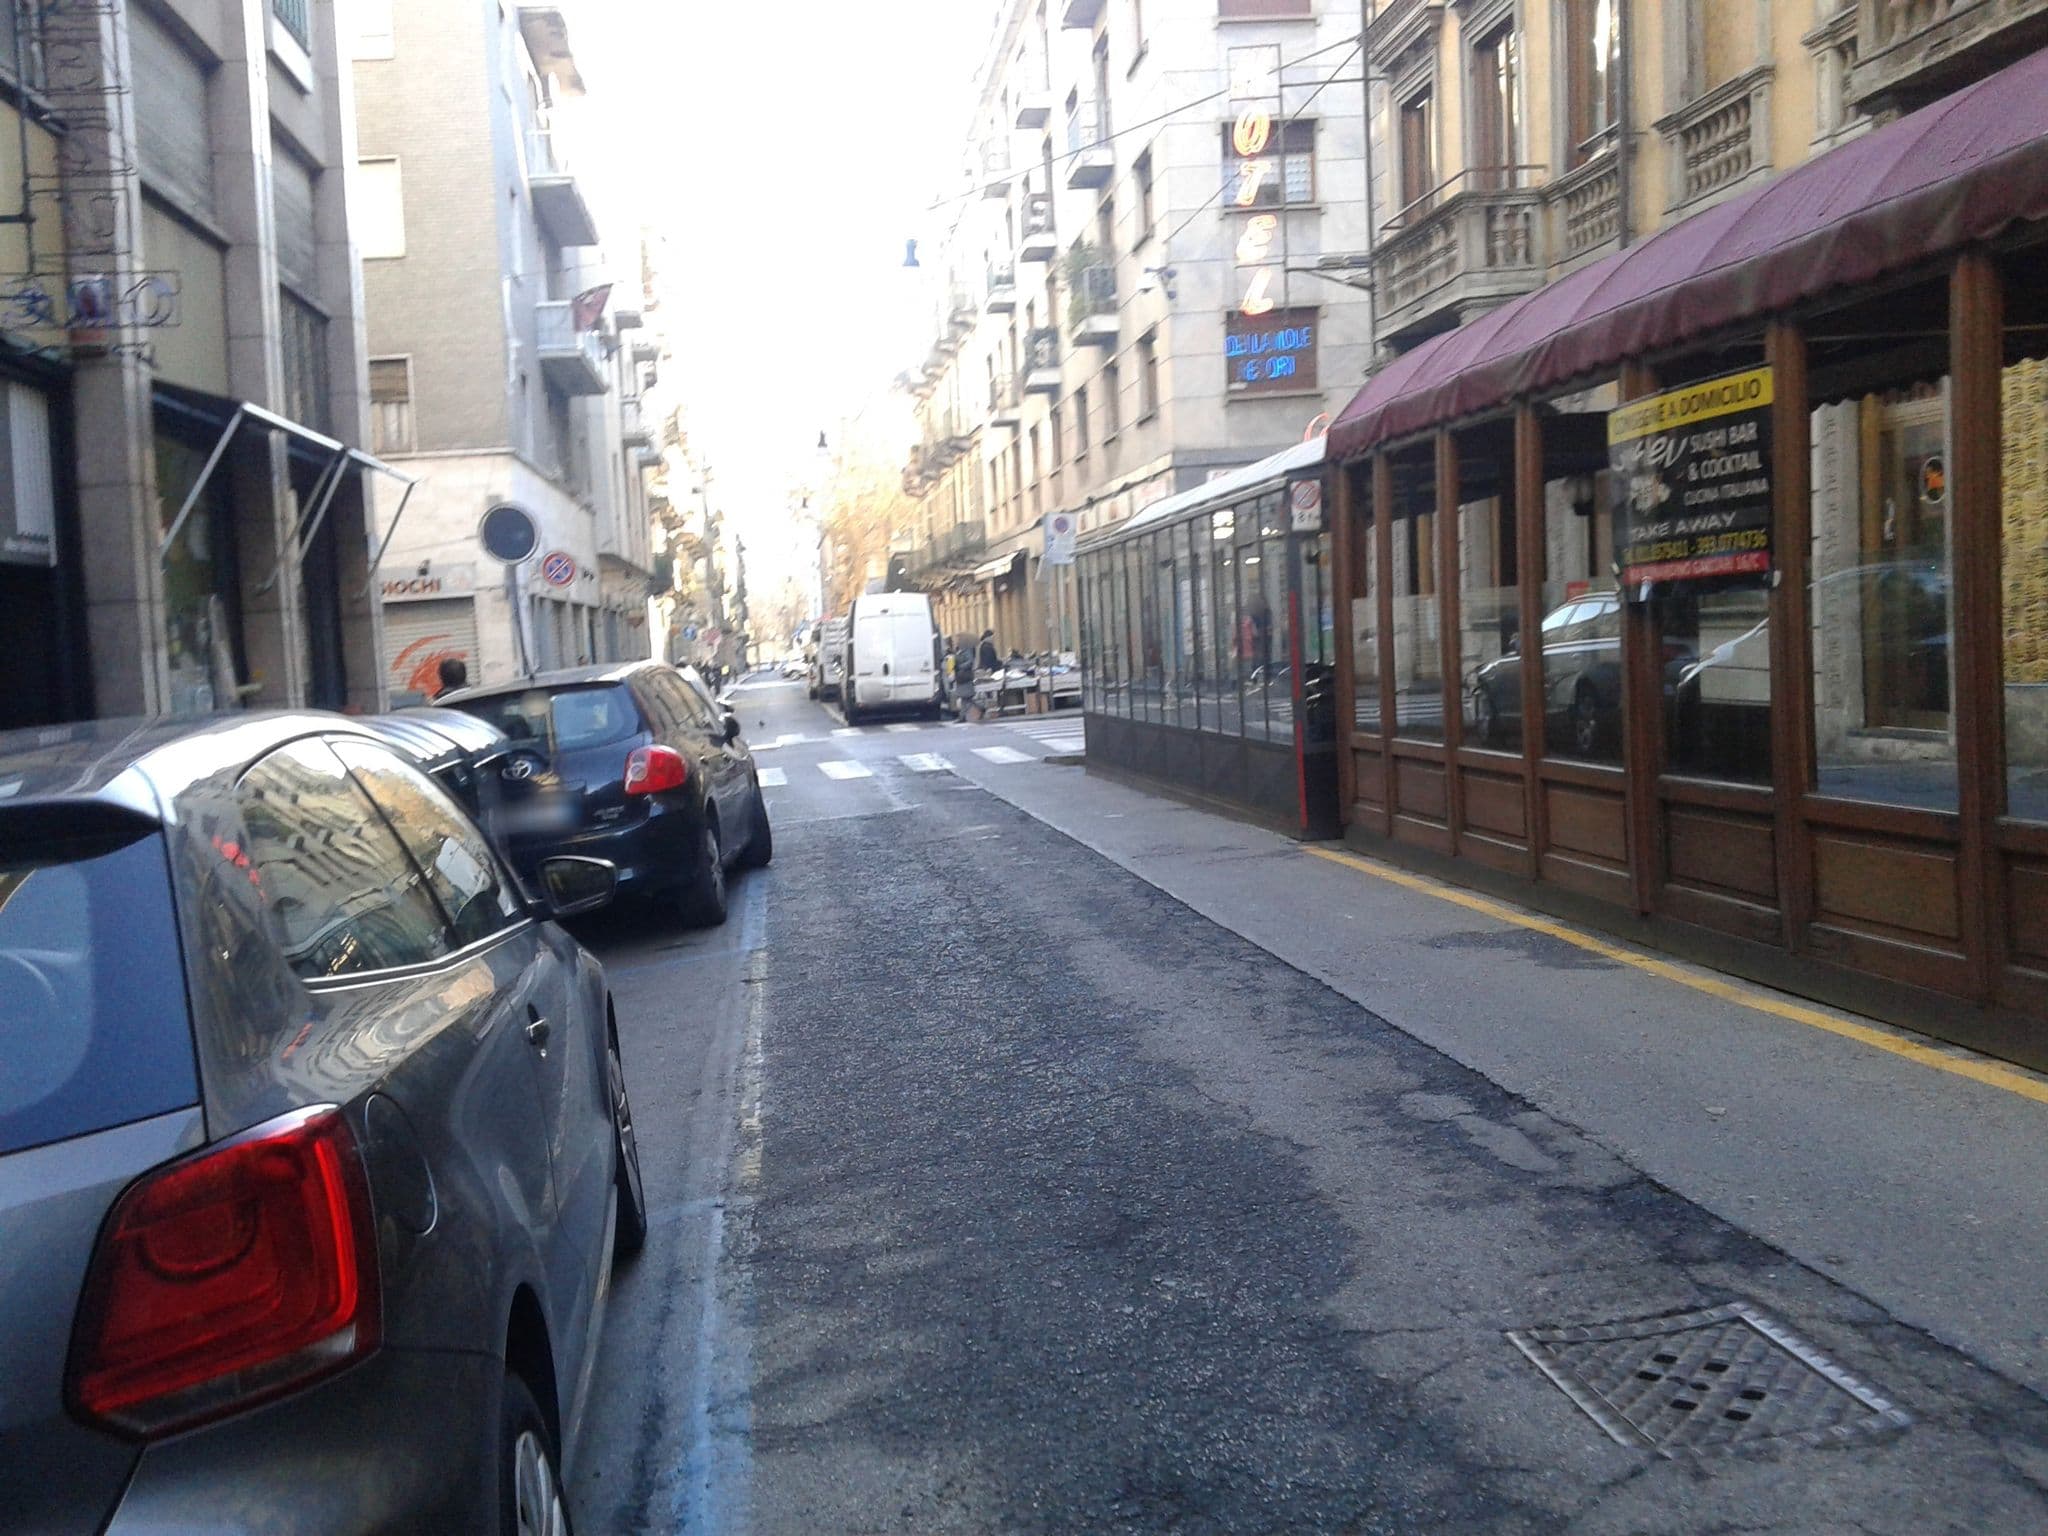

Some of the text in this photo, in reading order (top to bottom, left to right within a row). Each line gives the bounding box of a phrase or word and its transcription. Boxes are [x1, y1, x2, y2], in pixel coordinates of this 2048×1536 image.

[1230, 48, 1278, 316] OTEL
[1680, 378, 1761, 416] DOMICILIO
[1691, 427, 1727, 453] SUSHI
[1728, 421, 1758, 445] BAR
[1700, 451, 1763, 479] COCKTAIL
[1631, 511, 1737, 542] TAKE AWAY
